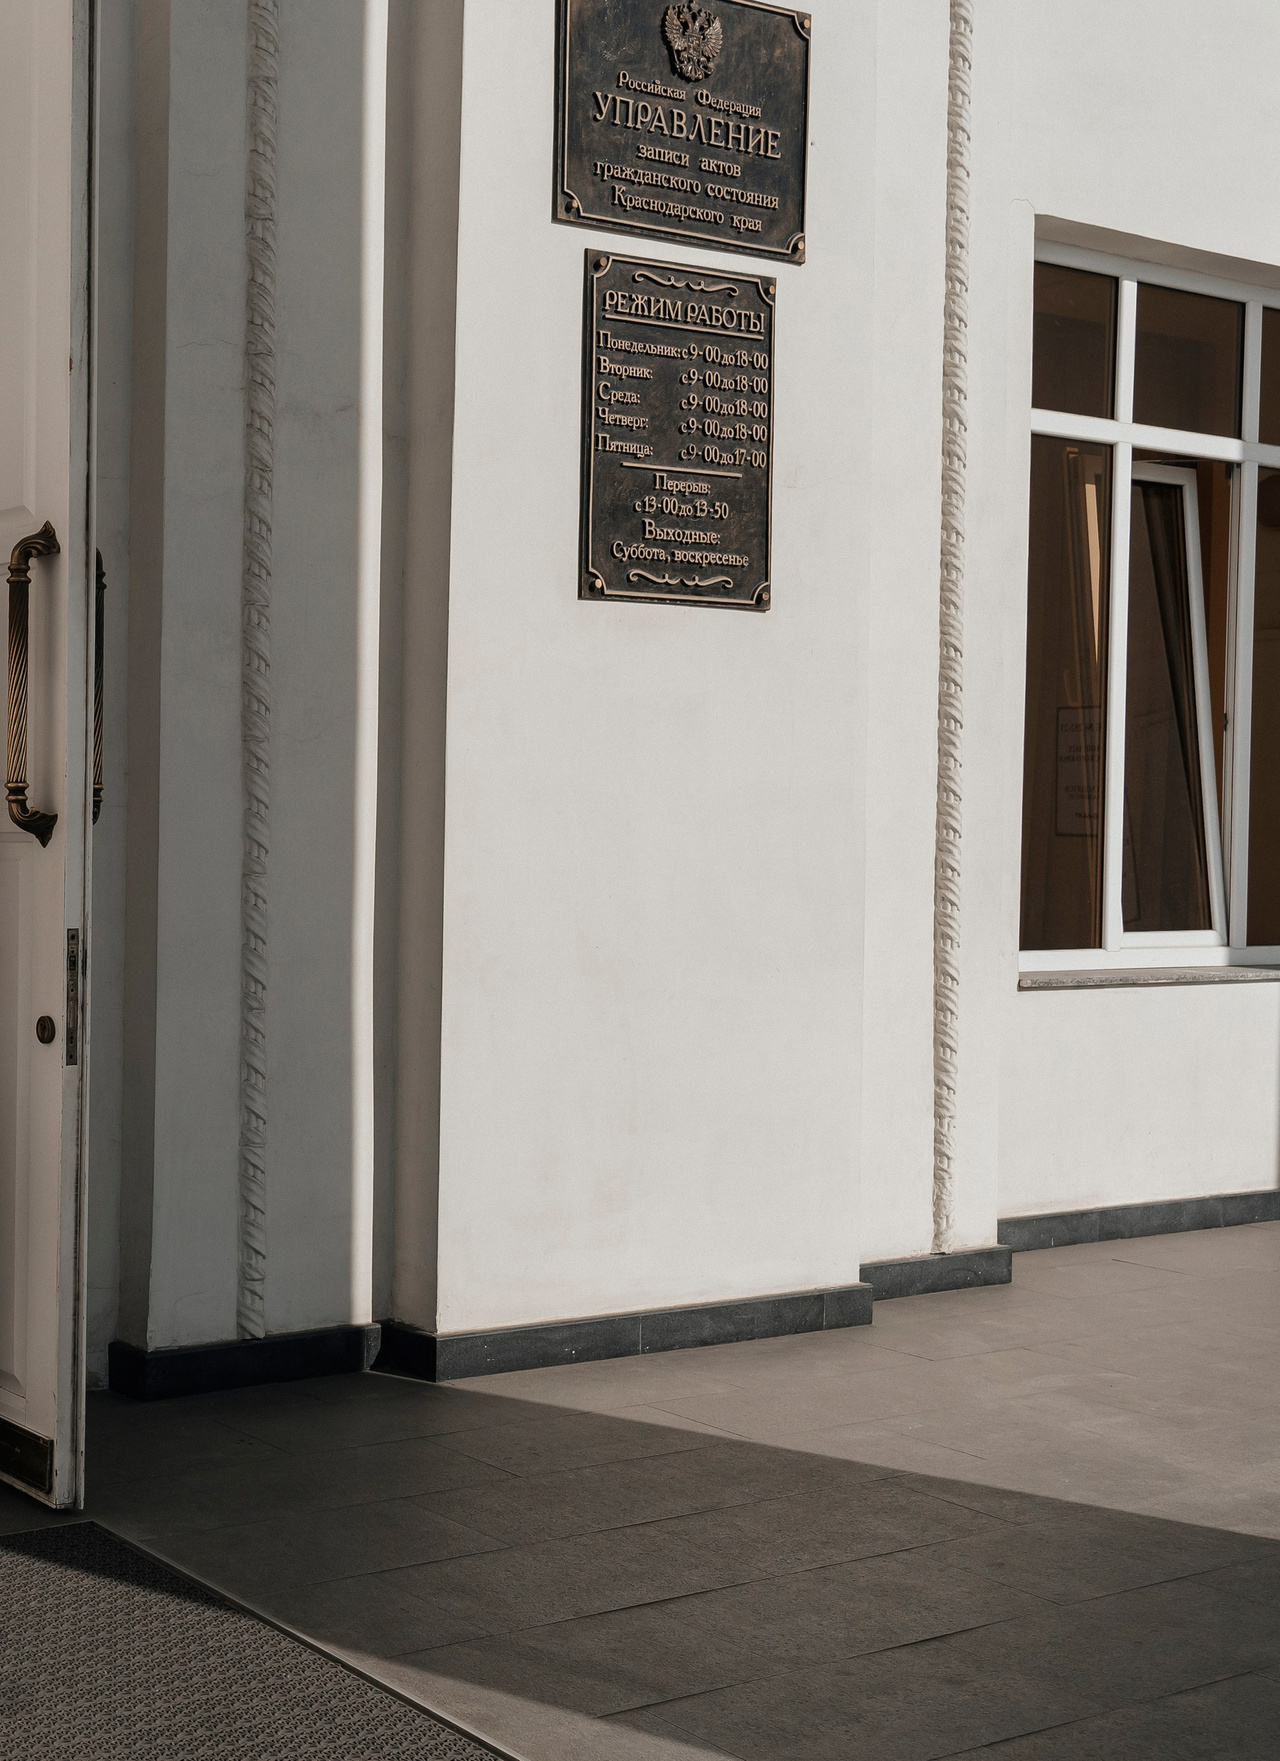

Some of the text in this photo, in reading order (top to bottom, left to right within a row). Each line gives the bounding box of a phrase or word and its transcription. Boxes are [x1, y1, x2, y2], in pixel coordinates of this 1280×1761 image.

[618, 70, 762, 118] Российская Федерация
[594, 91, 782, 159] УПРАВЛЕНИЕ
[638, 145, 742, 177] записи актов
[595, 161, 779, 209] гражданского состояния
[613, 185, 762, 233] Краснодарского края
[605, 290, 765, 333] РЕЖИМ РАБОТЫ
[654, 473, 711, 495] Перерыв:
[644, 519, 721, 544] Выходные:
[613, 541, 749, 568] Суббота, воскресенье
